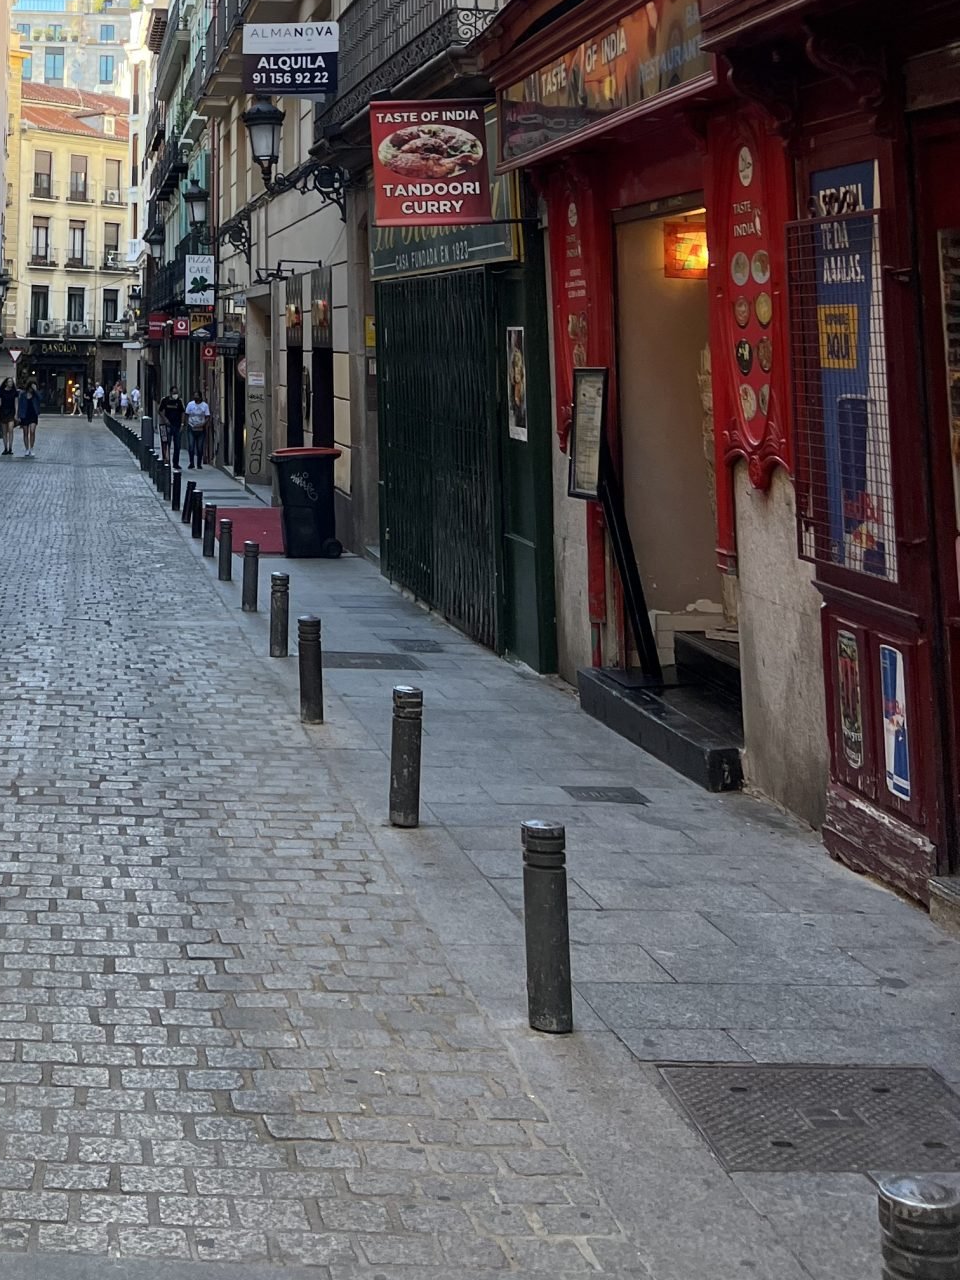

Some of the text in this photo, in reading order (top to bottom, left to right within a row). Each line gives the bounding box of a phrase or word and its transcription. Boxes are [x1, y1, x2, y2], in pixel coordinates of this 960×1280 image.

[250, 26, 333, 39] ALMANOVA
[257, 55, 326, 71] ALQUILA
[541, 63, 567, 97] TASTE
[585, 43, 598, 73] OF
[601, 27, 628, 65] INDIA
[252, 71, 329, 84] 91 156 92 22
[376, 110, 479, 123] TASTE OF INDIA
[382, 181, 481, 197] TANDOORI
[401, 200, 464, 214] CURRY
[732, 200, 752, 215] TASTE
[733, 222, 756, 237] INDIA
[833, 220, 850, 250] DA
[188, 255, 212, 264] PIZZA
[395, 240, 469, 271] CASA FUNDADA EN 1923
[189, 265, 211, 274] CAFÉ
[192, 314, 213, 324] ATM
[41, 343, 77, 354] BANDIDA
